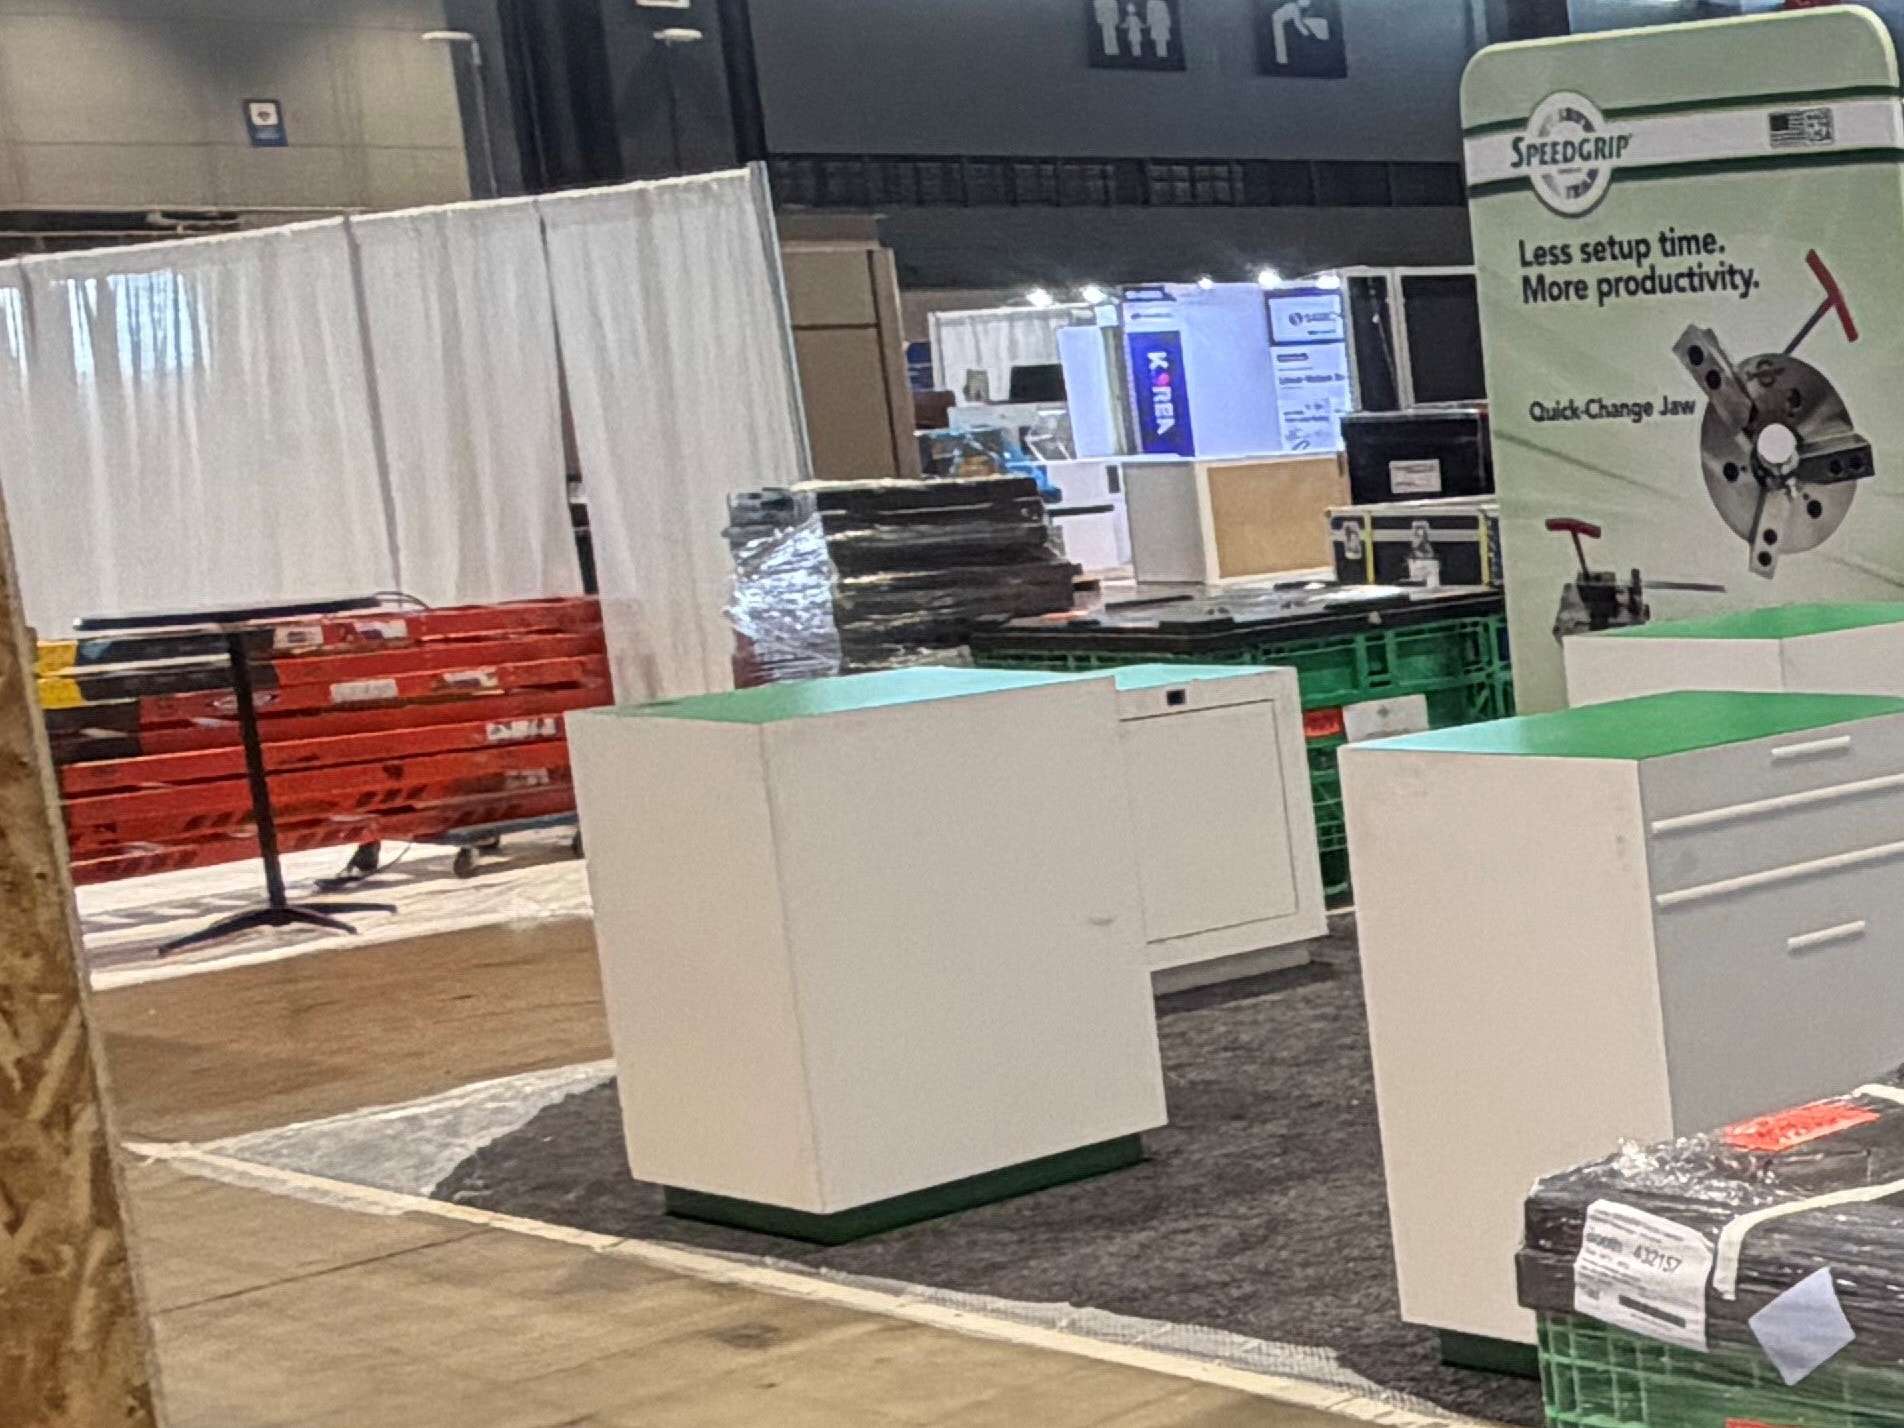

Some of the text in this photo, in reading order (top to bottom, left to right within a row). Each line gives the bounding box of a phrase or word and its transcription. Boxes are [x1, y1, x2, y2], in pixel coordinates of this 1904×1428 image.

[1518, 226, 1726, 268] Less setup time.
[1522, 260, 1760, 307] More productivity.
[1528, 396, 1696, 424] Quick-Change Jaw
